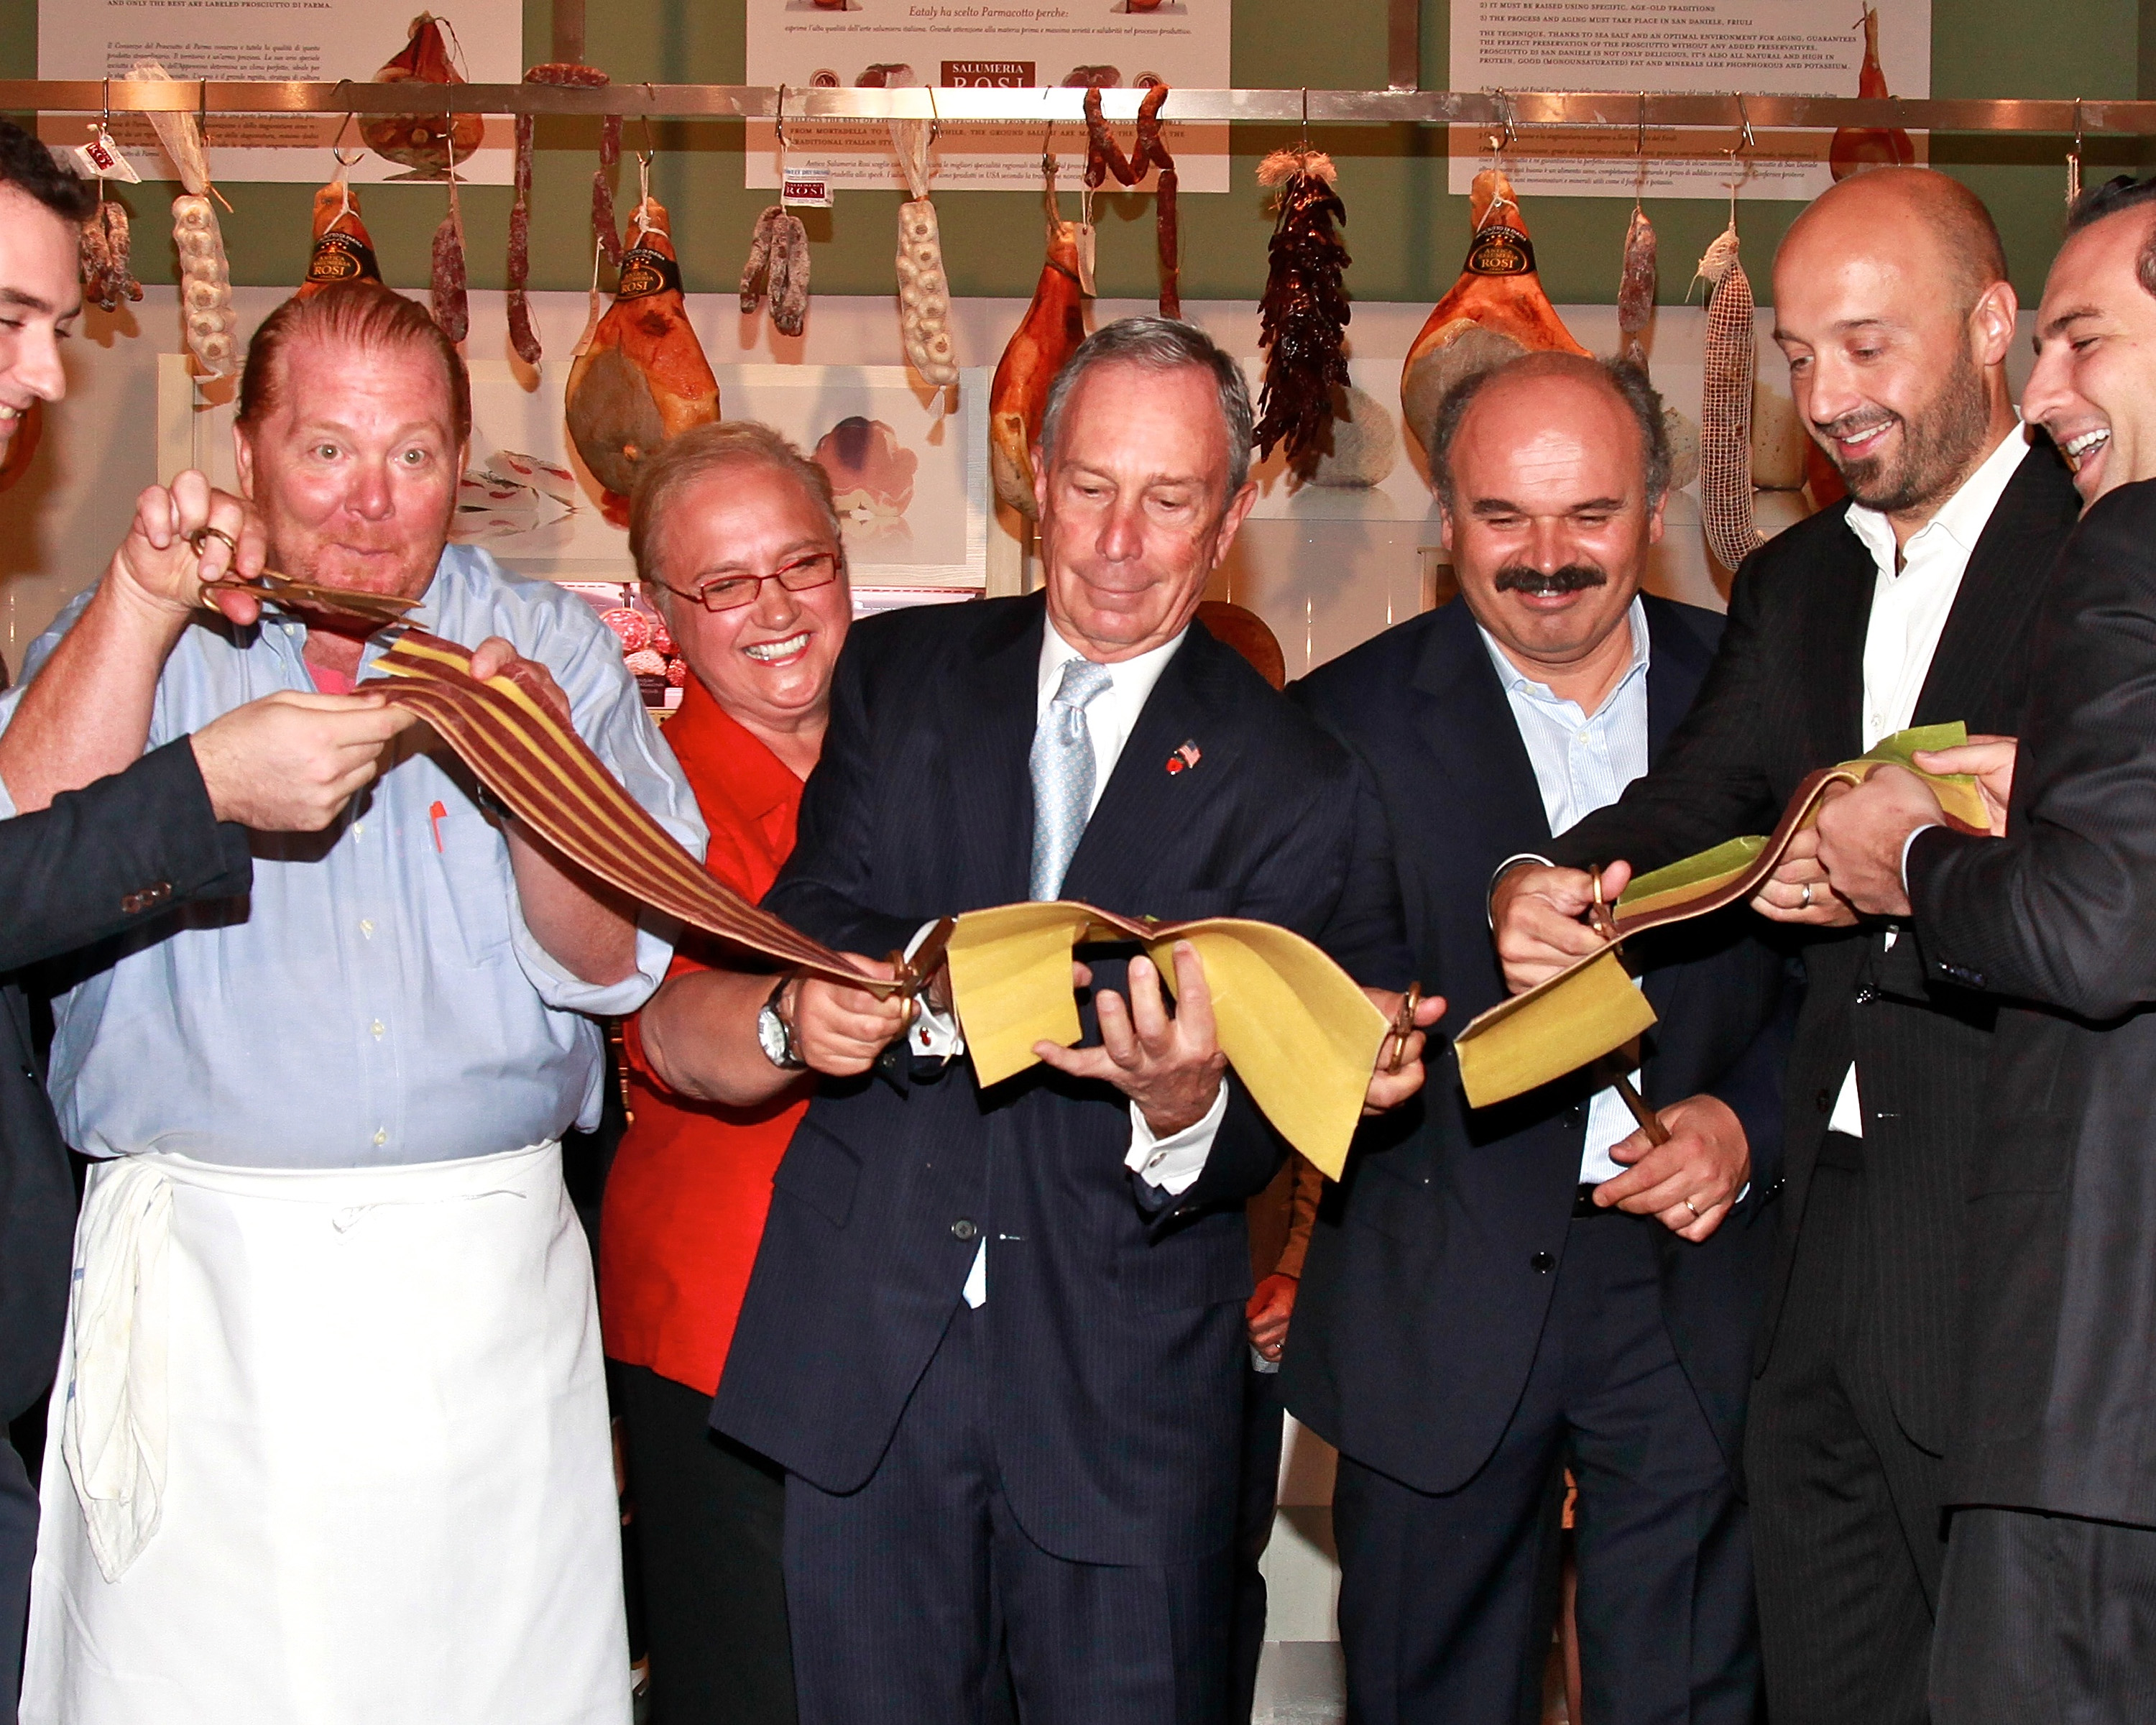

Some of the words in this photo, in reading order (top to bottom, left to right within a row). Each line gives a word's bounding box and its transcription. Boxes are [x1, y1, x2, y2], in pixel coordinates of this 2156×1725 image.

[910, 6, 939, 20] Eataly
[940, 7, 952, 17] ha
[954, 7, 979, 17] scelto
[982, 7, 1034, 18] Parmacotto
[1036, 8, 1069, 21] perche:
[953, 64, 1023, 73] SALUMERIA
[1482, 259, 1514, 268] ROSI
[313, 266, 345, 275] ROSI
